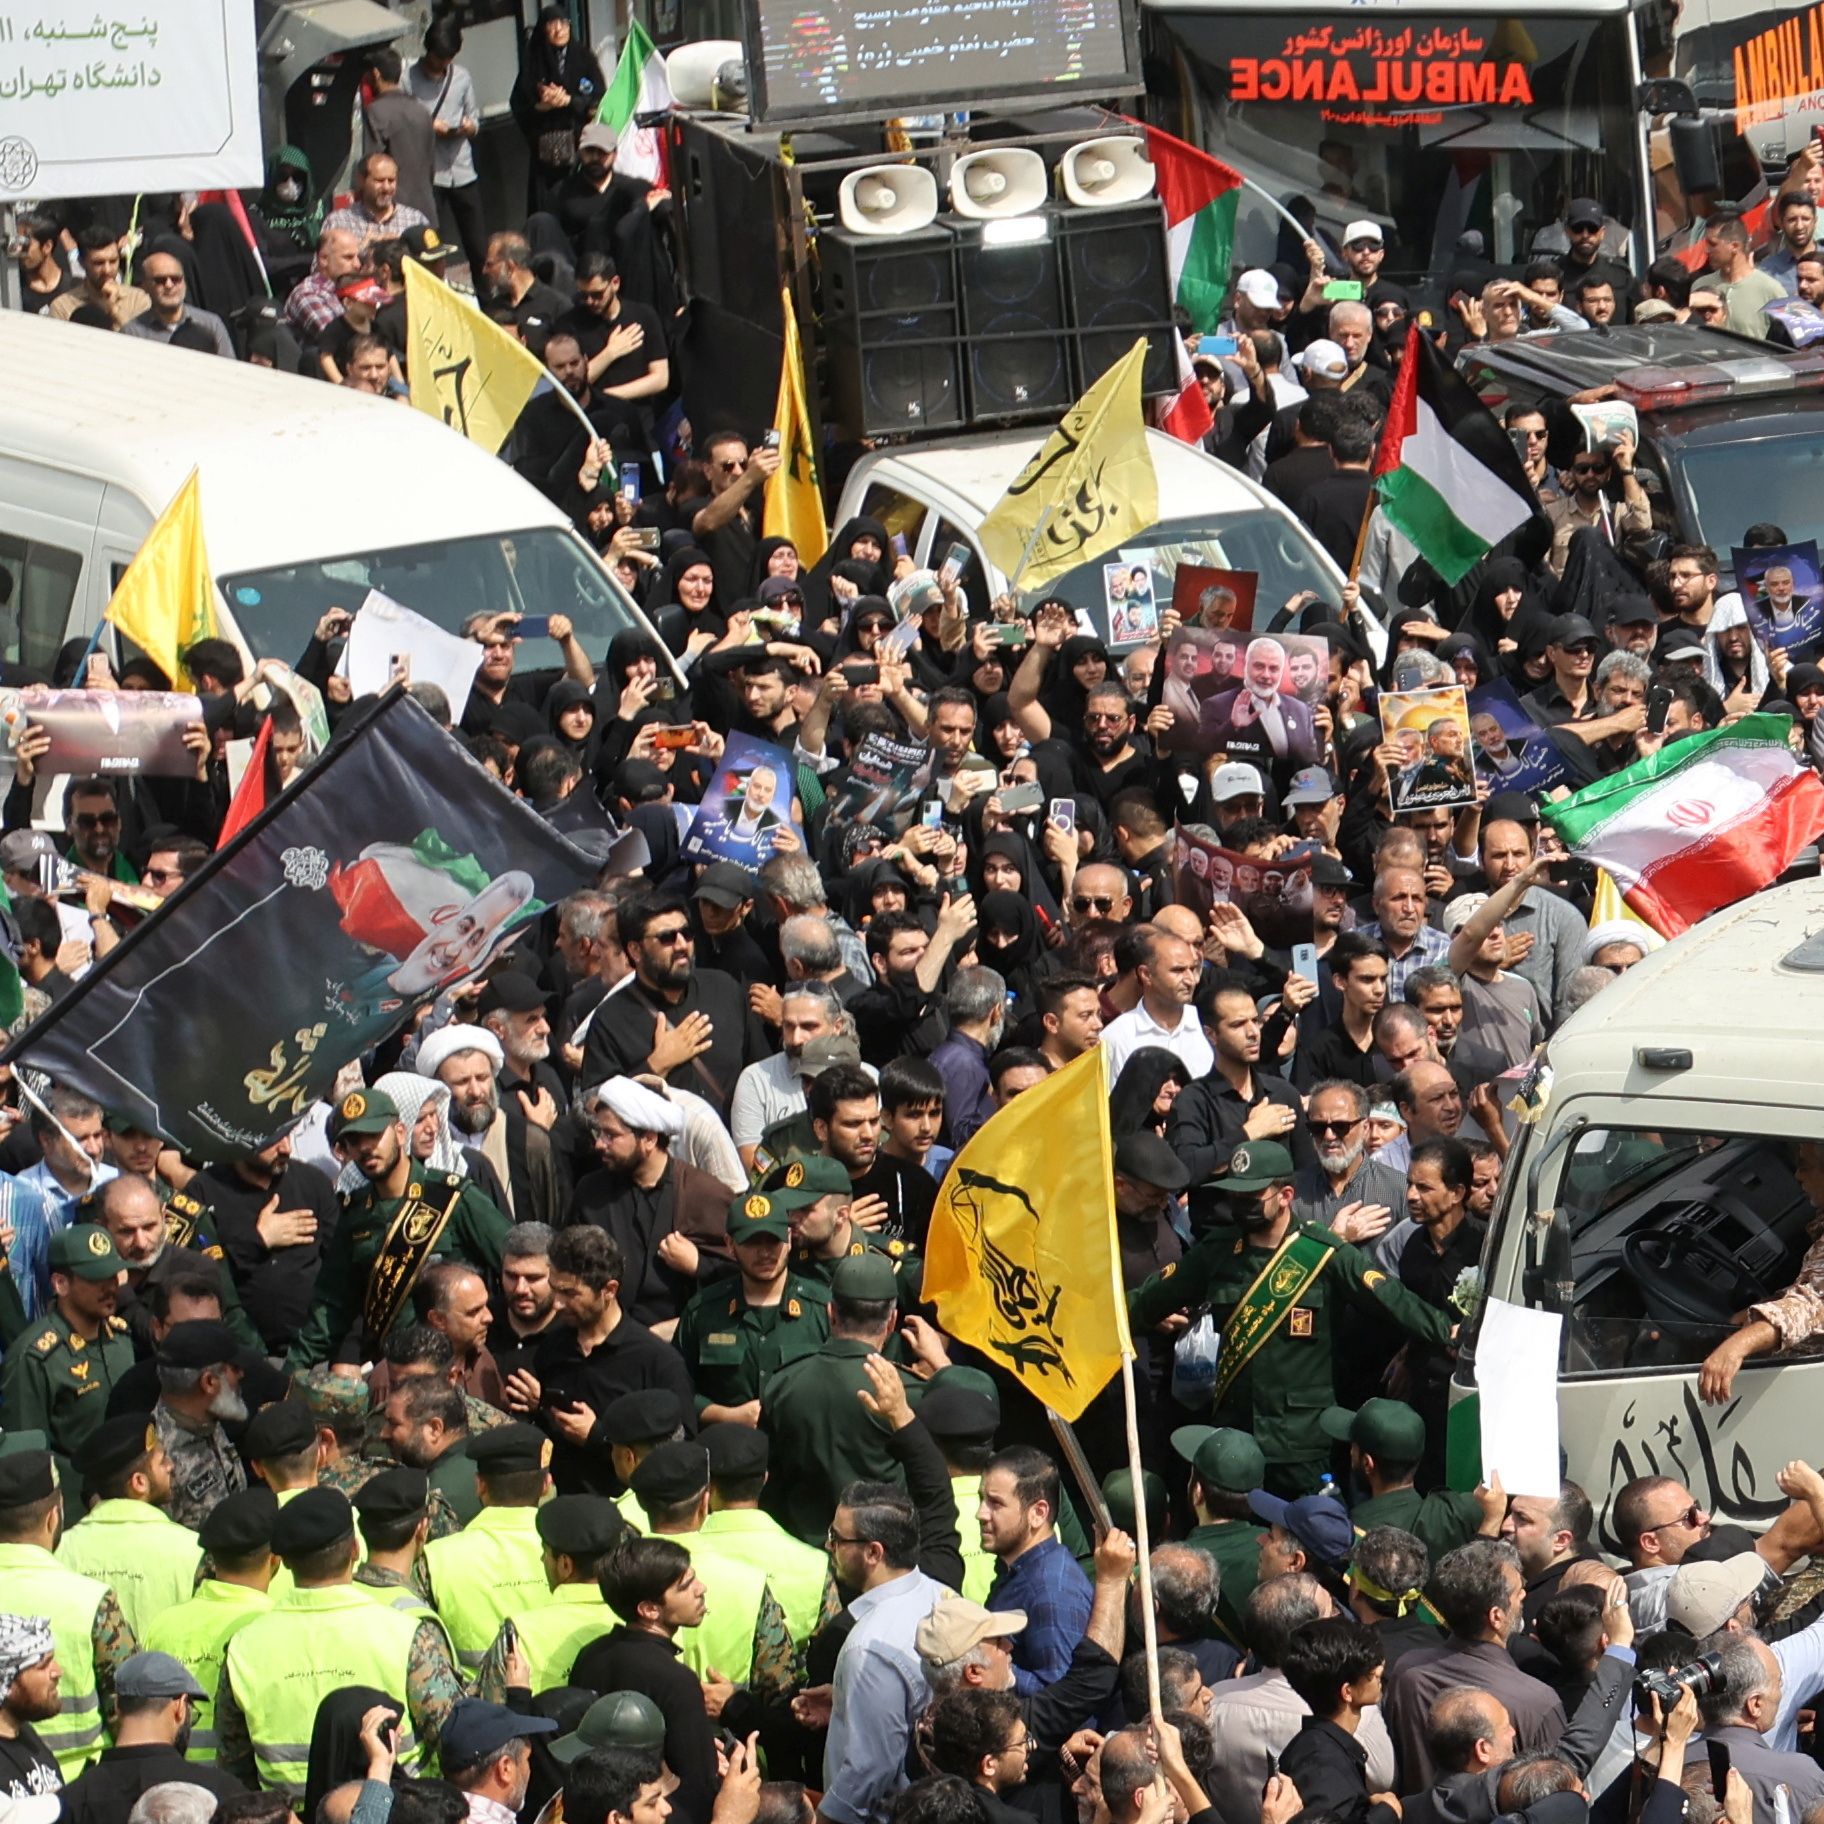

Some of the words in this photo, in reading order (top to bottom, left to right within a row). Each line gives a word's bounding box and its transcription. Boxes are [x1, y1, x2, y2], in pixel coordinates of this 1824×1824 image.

[1281, 25, 1334, 56] کشور
[1331, 25, 1412, 58] اورژانس
[1416, 26, 1484, 58] سازمان
[0, 66, 67, 98] تهران
[73, 60, 160, 90] دانشگاه
